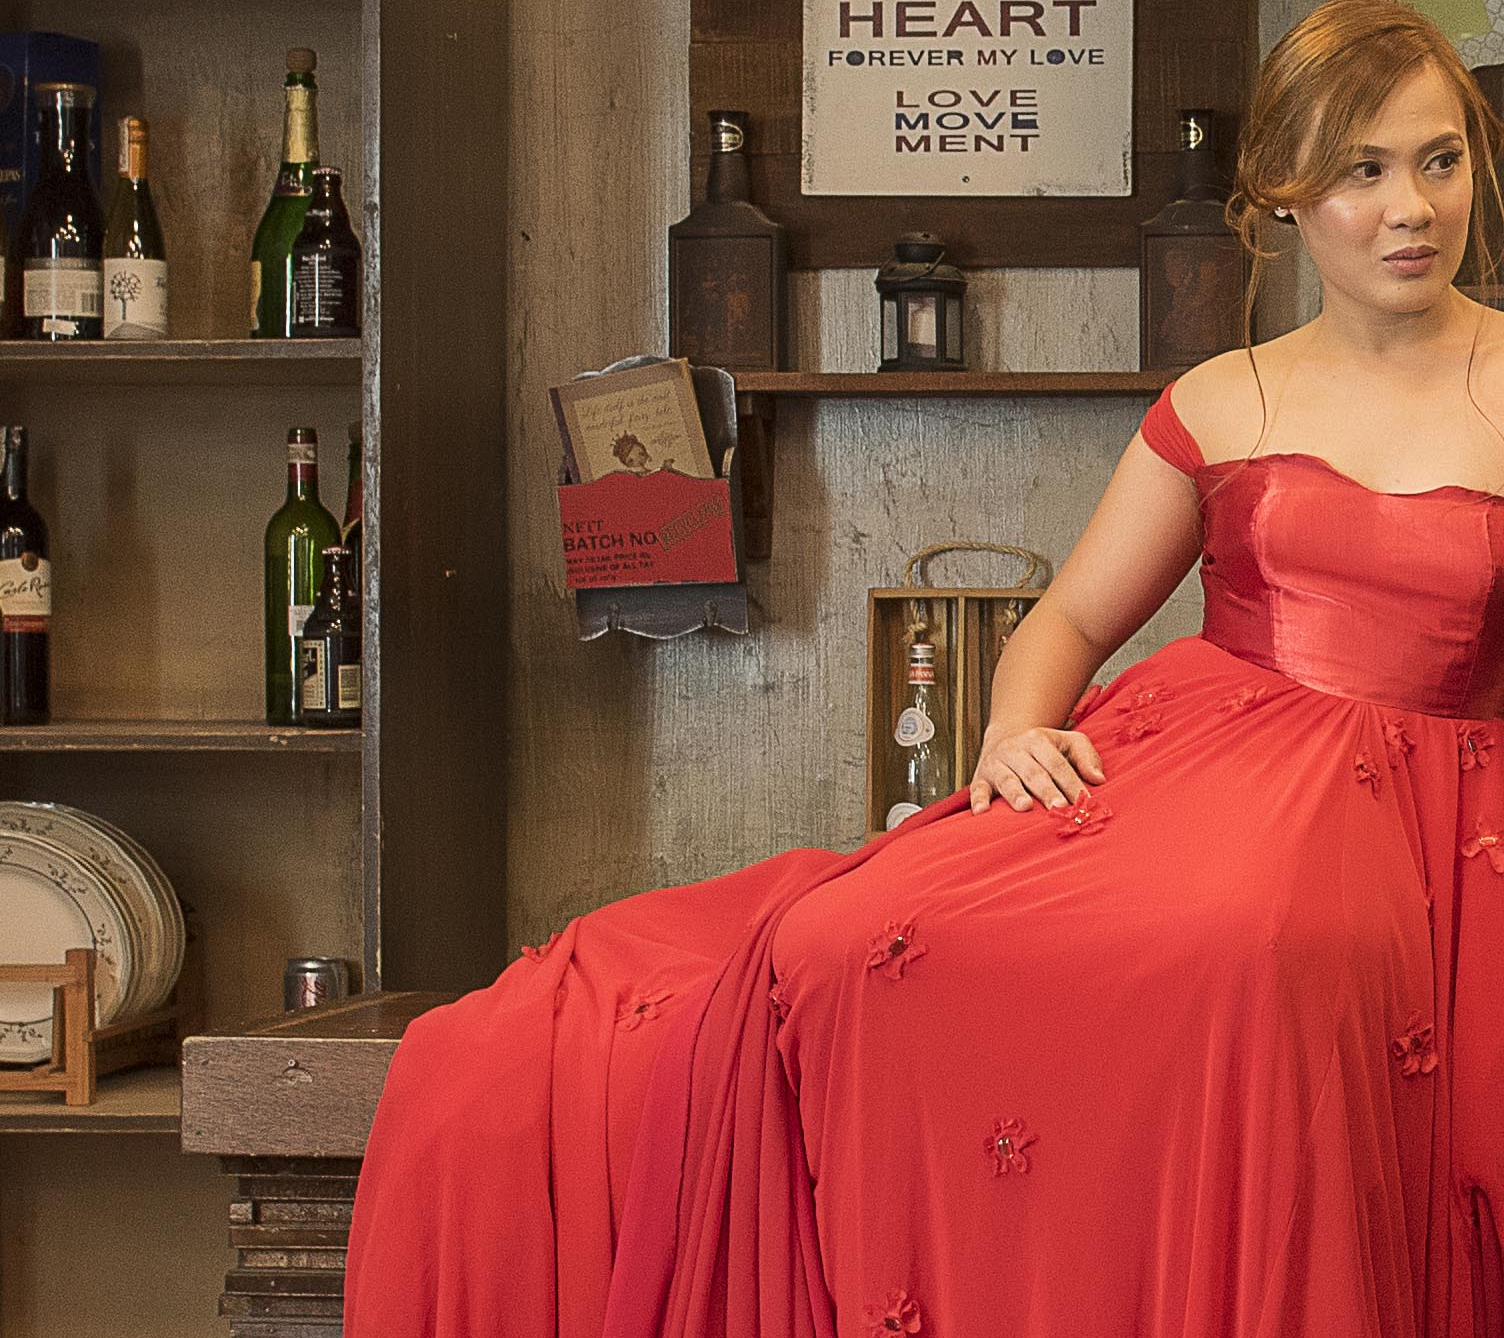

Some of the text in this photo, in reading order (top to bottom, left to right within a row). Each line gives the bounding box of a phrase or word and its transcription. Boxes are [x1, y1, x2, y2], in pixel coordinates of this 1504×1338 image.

[838, 0, 1098, 39] HEART
[828, 48, 1106, 67] FOREVER MY LOVE
[896, 89, 1039, 108] LOVE
[895, 112, 1040, 131] MOVE
[895, 134, 1041, 153] MENT
[563, 533, 625, 552] BATCH
